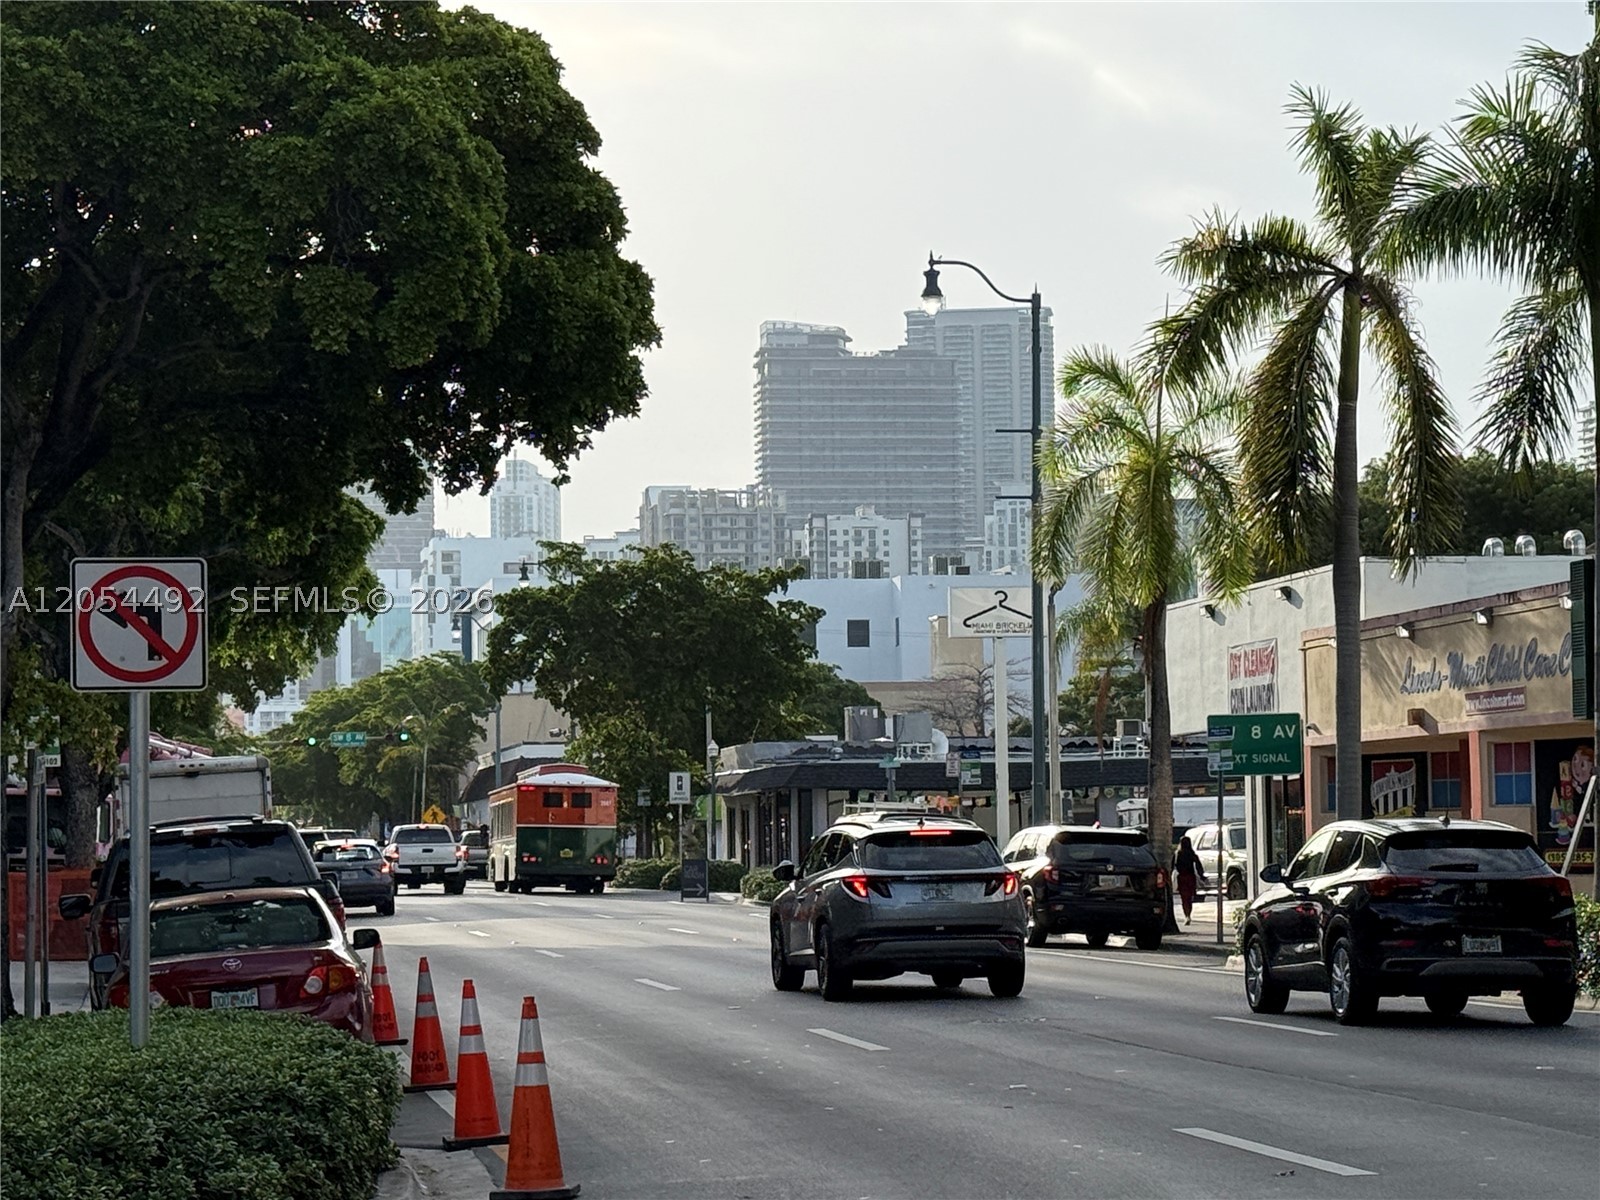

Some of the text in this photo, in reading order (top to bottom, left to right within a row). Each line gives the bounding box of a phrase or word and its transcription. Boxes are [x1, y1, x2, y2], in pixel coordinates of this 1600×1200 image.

[1485, 642, 1524, 686] Child
[1523, 636, 1559, 682] Care
[1251, 725, 1262, 739] 8
[1273, 724, 1296, 739] AV
[1234, 753, 1292, 764] XT SIGNAL
